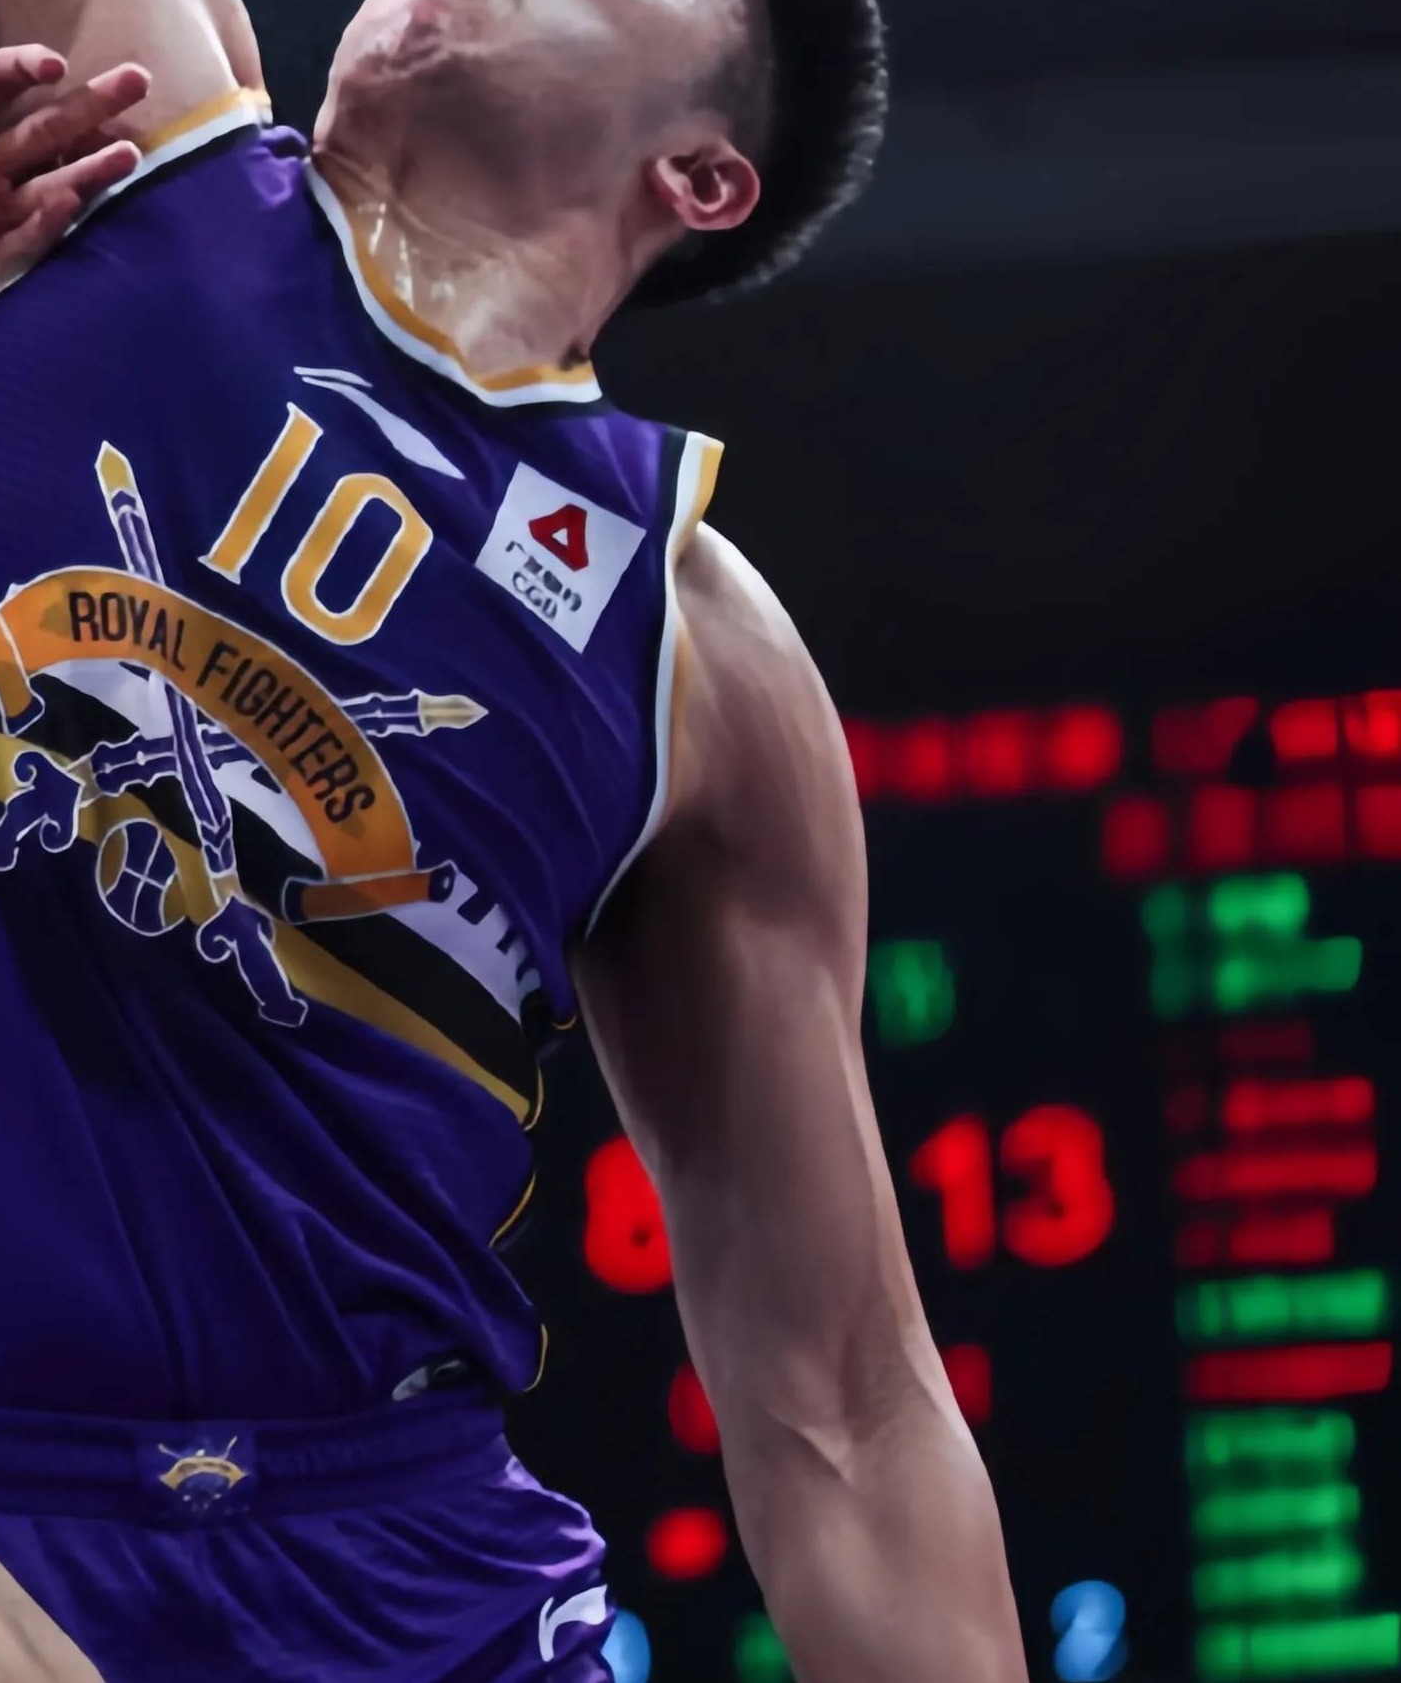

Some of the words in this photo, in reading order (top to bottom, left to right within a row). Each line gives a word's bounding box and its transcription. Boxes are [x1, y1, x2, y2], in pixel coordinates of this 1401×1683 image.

[197, 401, 435, 646] 10
[67, 590, 188, 673] ROYAL
[194, 639, 377, 825] FIGHTERS
[906, 1102, 1117, 1272] 13
